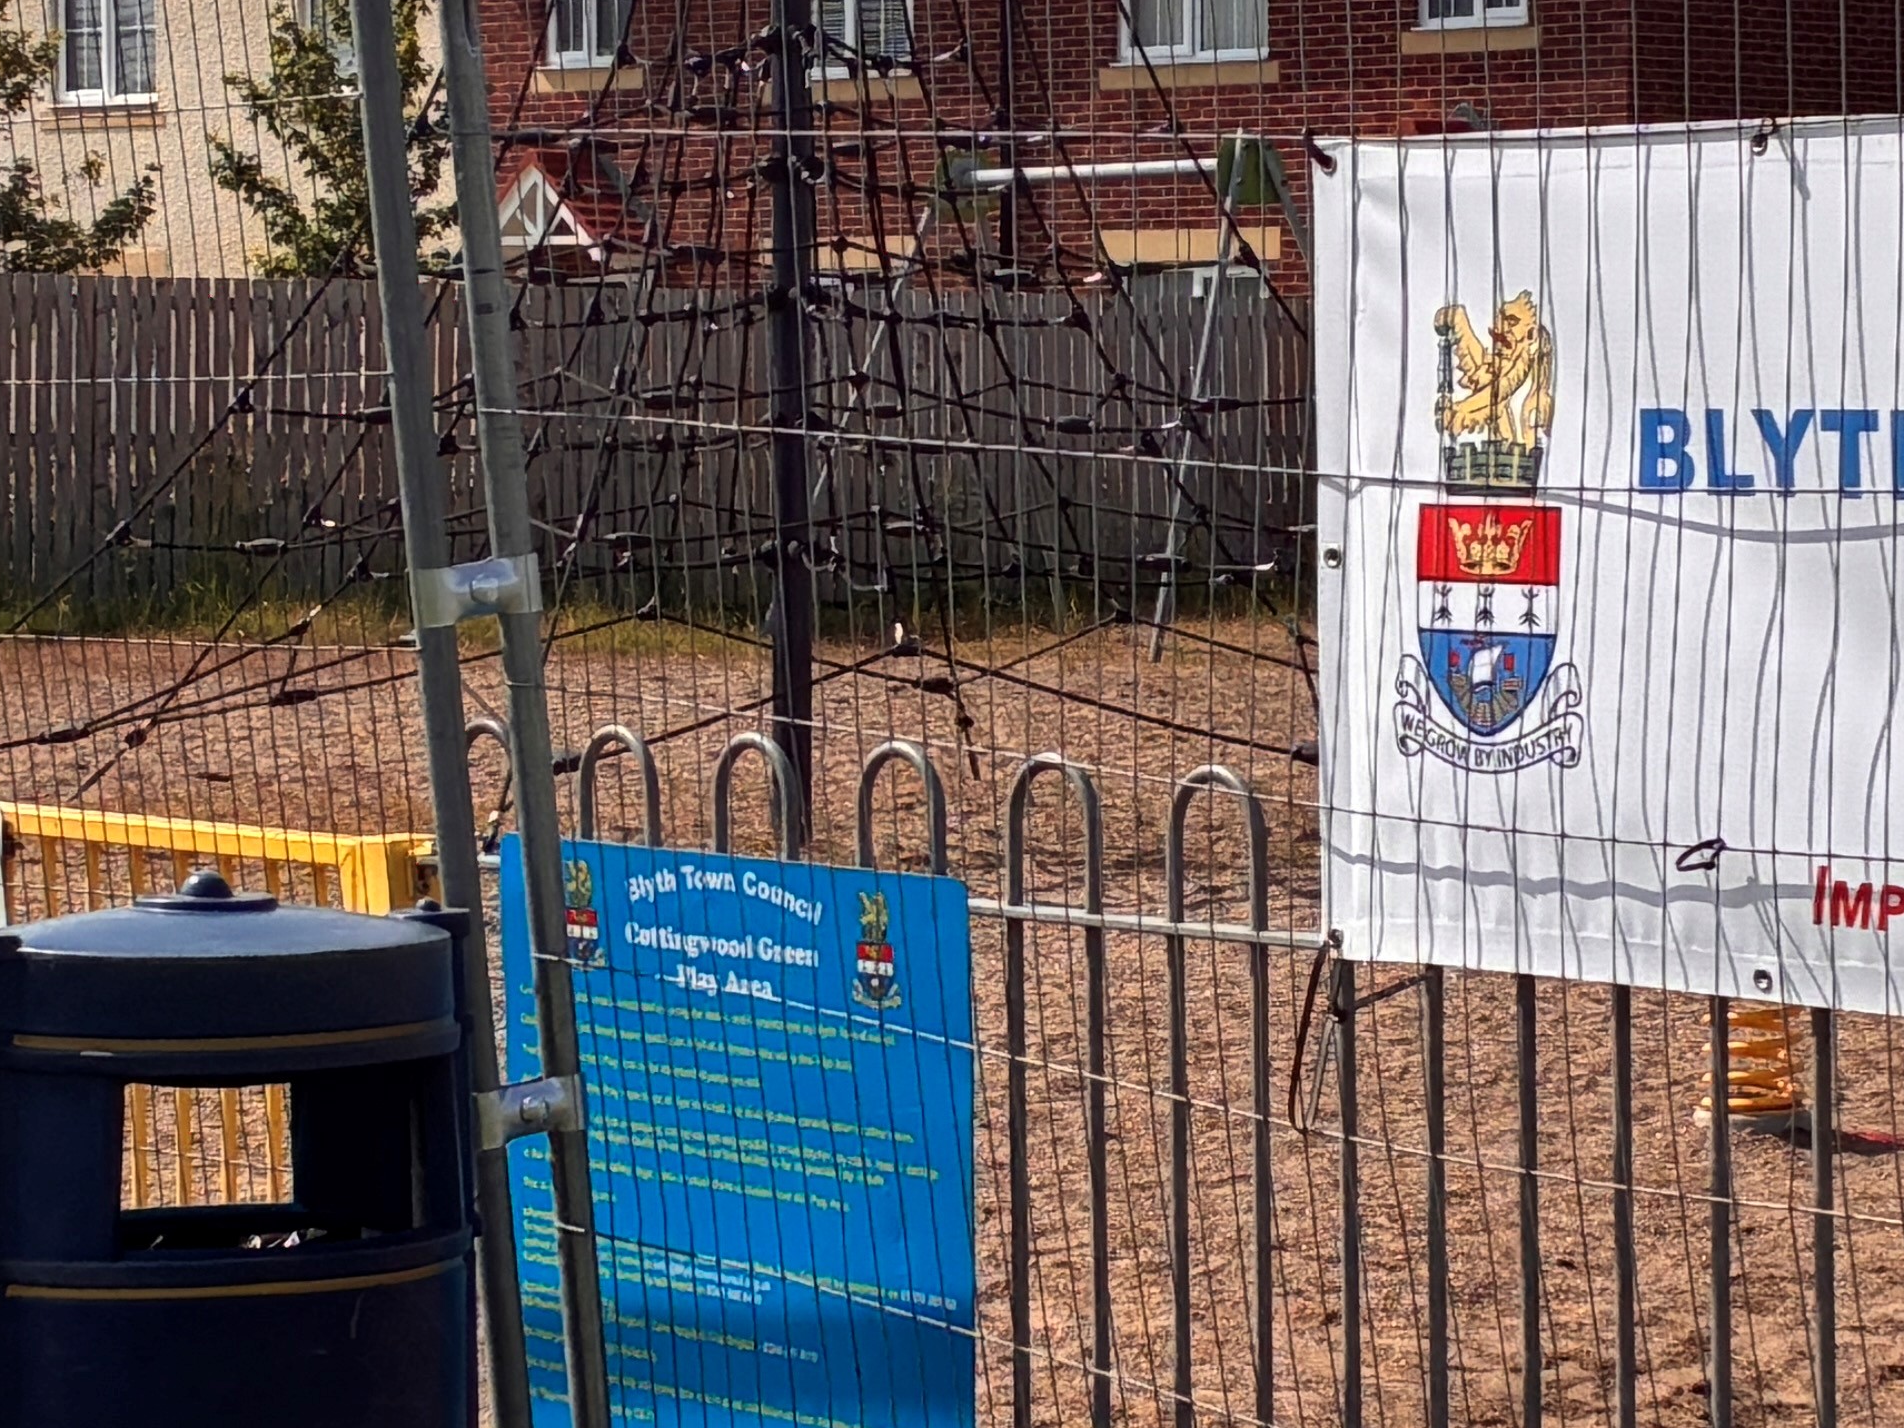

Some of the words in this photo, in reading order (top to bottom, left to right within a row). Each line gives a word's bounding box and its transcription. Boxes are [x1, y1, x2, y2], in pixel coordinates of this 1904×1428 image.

[1400, 711, 1424, 738] WE
[1474, 747, 1492, 767] BY
[625, 868, 677, 903] Blyth
[680, 865, 736, 892] Town
[742, 871, 823, 926] Council
[756, 936, 820, 968] Green
[724, 970, 774, 998] Area
